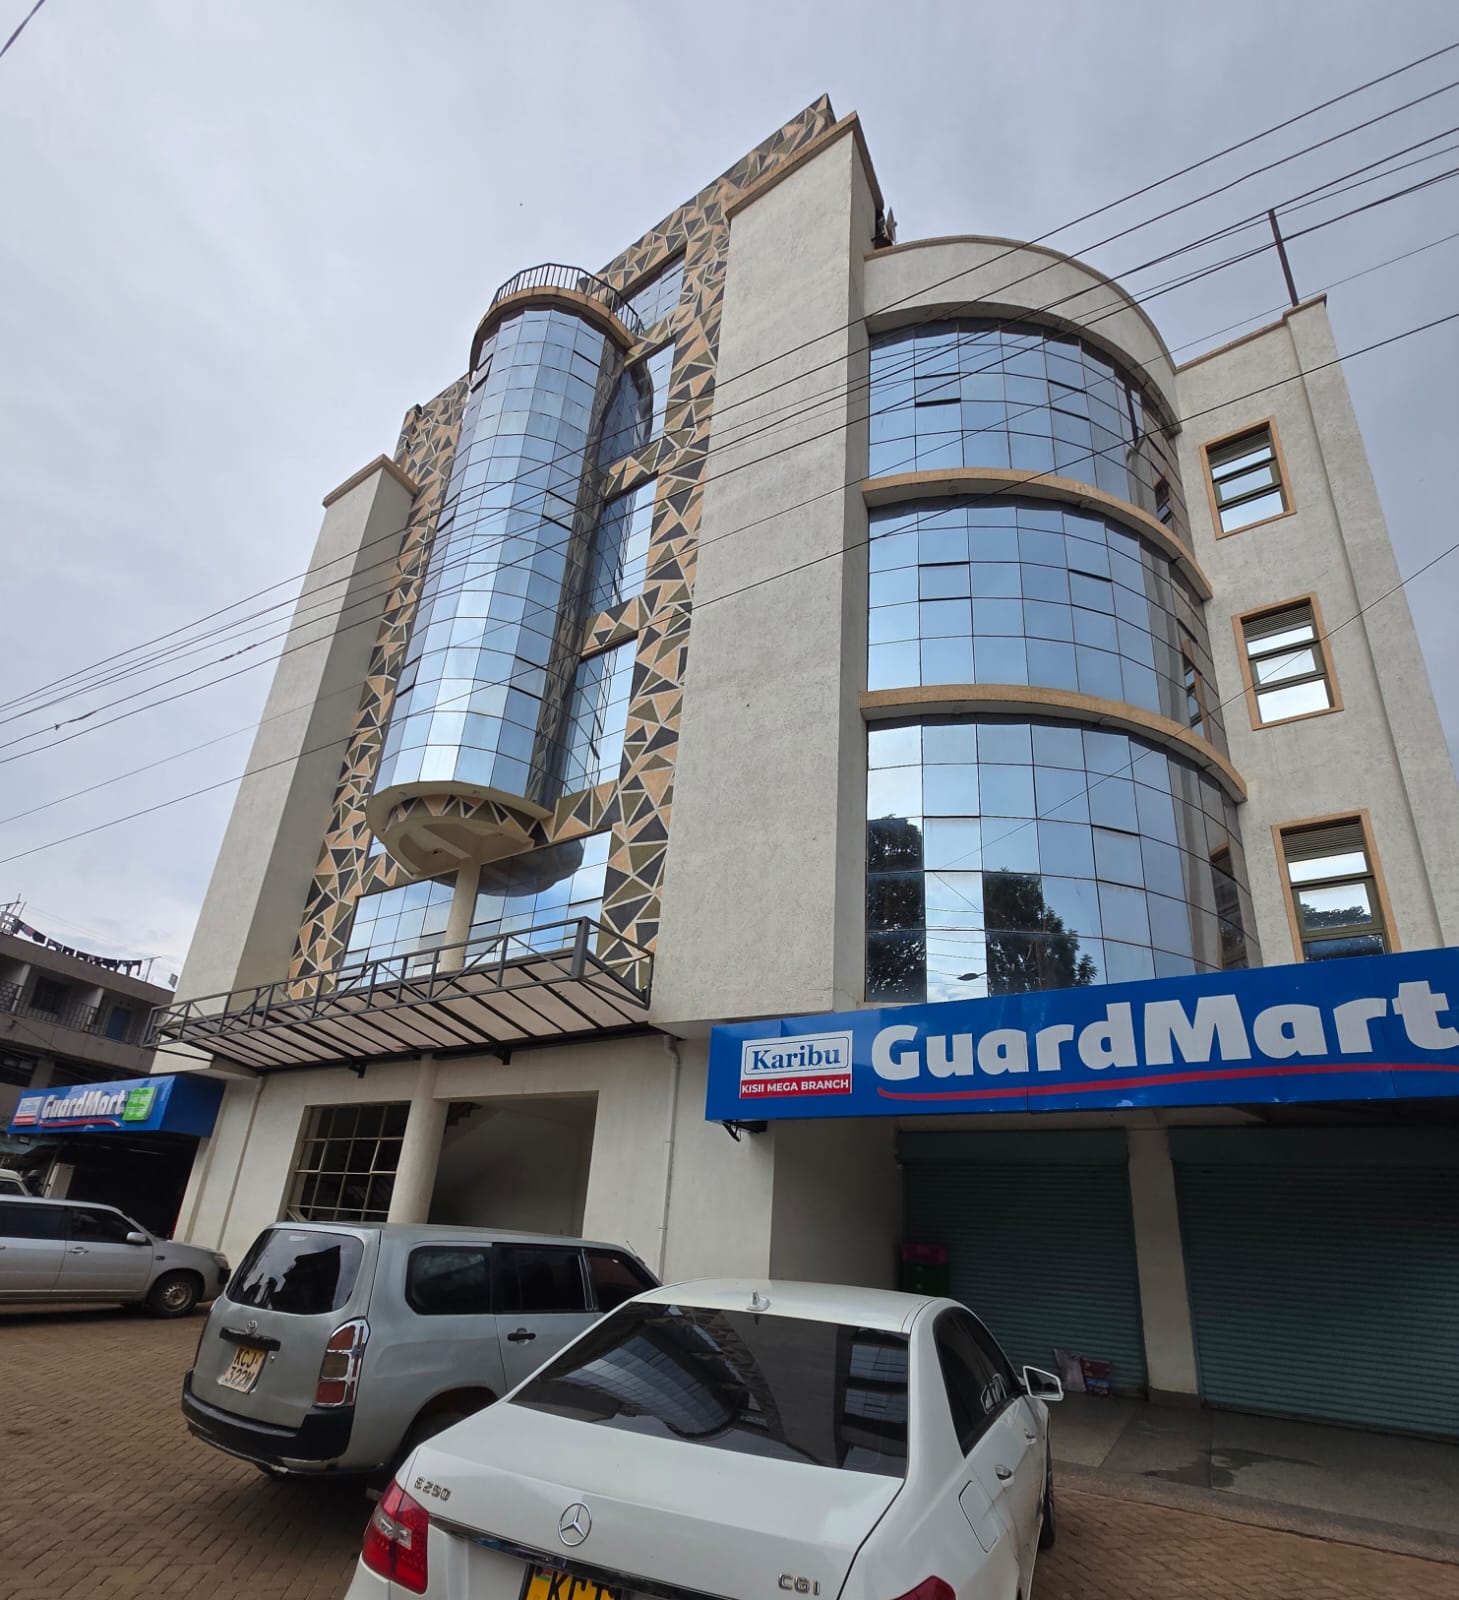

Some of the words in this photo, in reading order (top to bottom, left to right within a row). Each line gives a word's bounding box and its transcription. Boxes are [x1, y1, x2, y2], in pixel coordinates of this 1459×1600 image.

[871, 980, 1459, 1081] GuardMart
[751, 1045, 840, 1070] Karibu
[741, 1083, 765, 1093] KISII
[767, 1082, 798, 1092] MEGA
[801, 1079, 849, 1090] BRANCH
[41, 1090, 127, 1118] GuardMart
[778, 1574, 820, 1596] CGI
